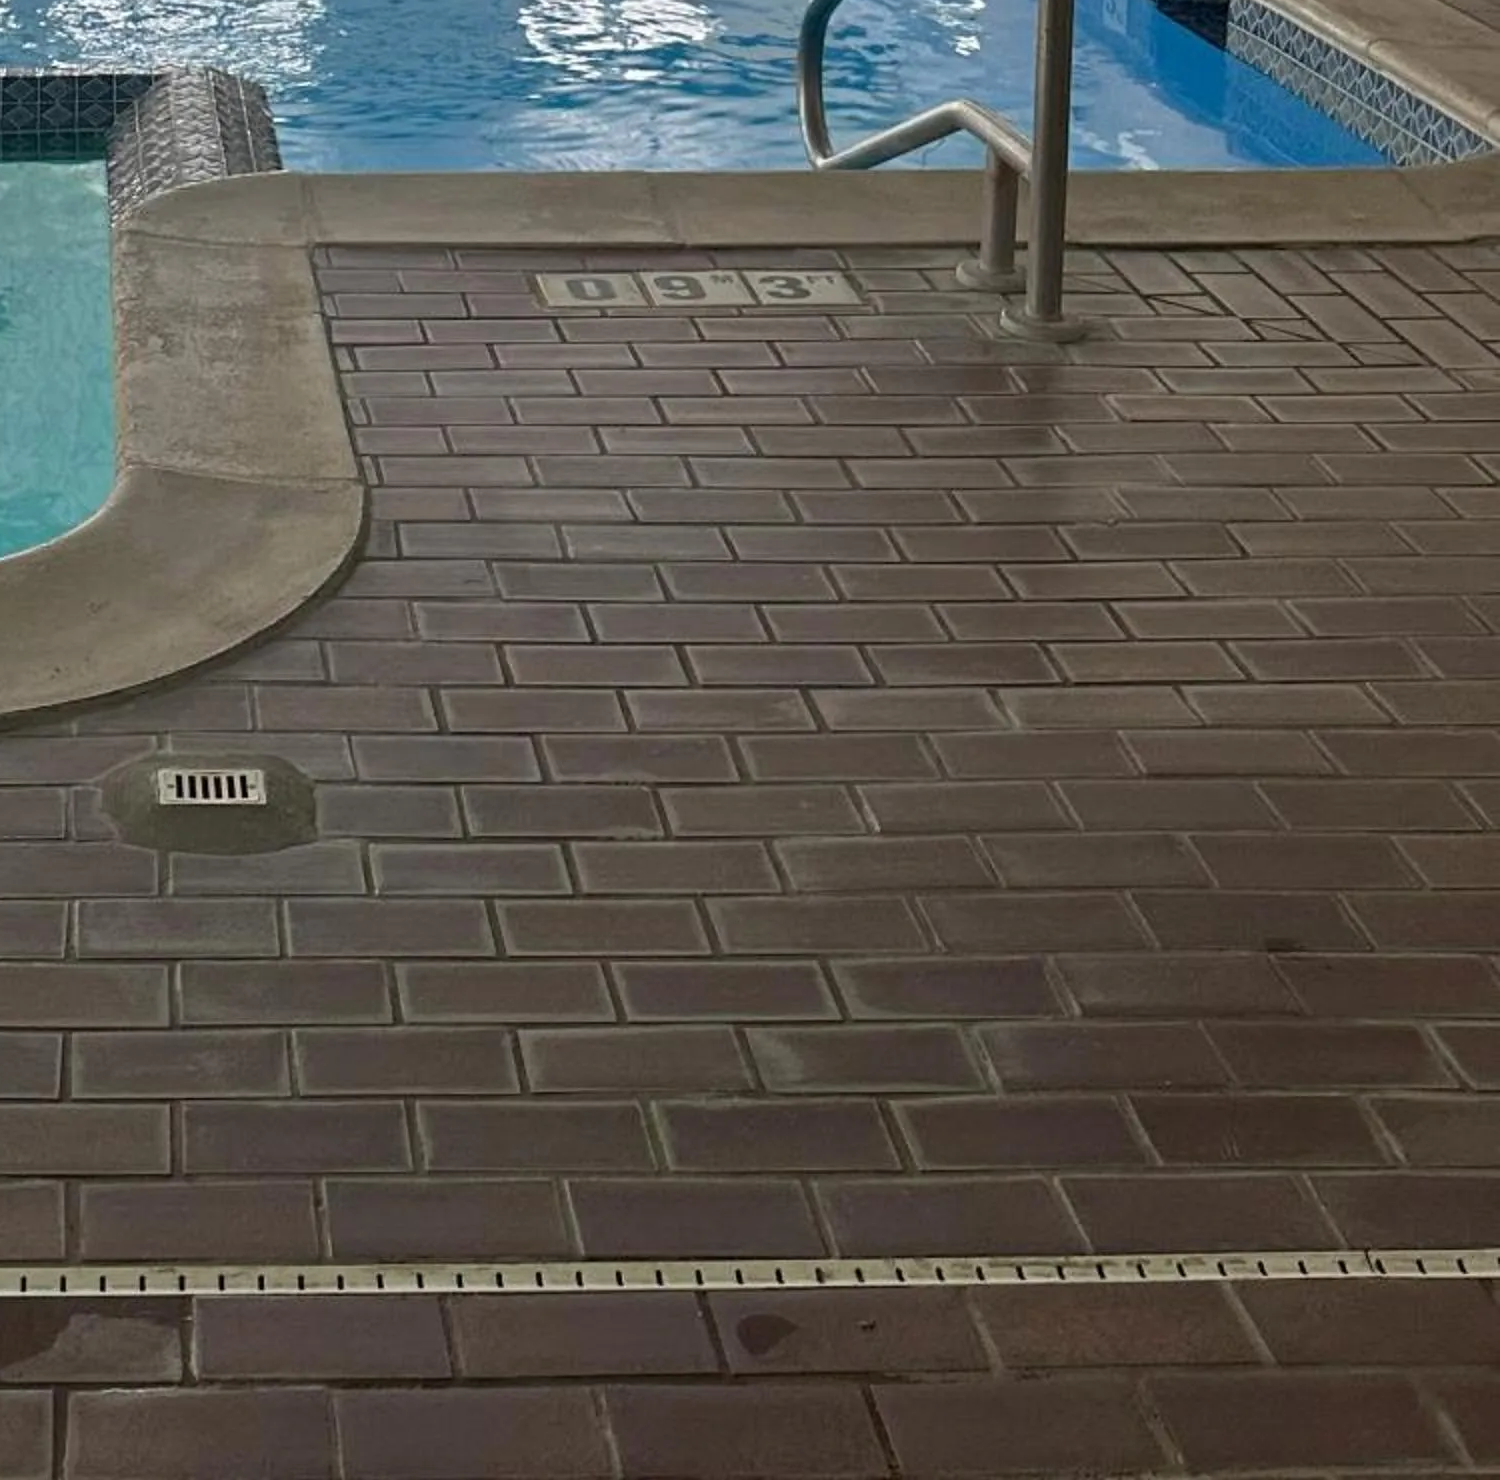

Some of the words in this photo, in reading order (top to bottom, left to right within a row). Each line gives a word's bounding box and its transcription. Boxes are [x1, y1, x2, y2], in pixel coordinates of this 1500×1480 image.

[565, 278, 618, 300] 0
[653, 275, 707, 300] 9
[759, 275, 812, 299] 3
